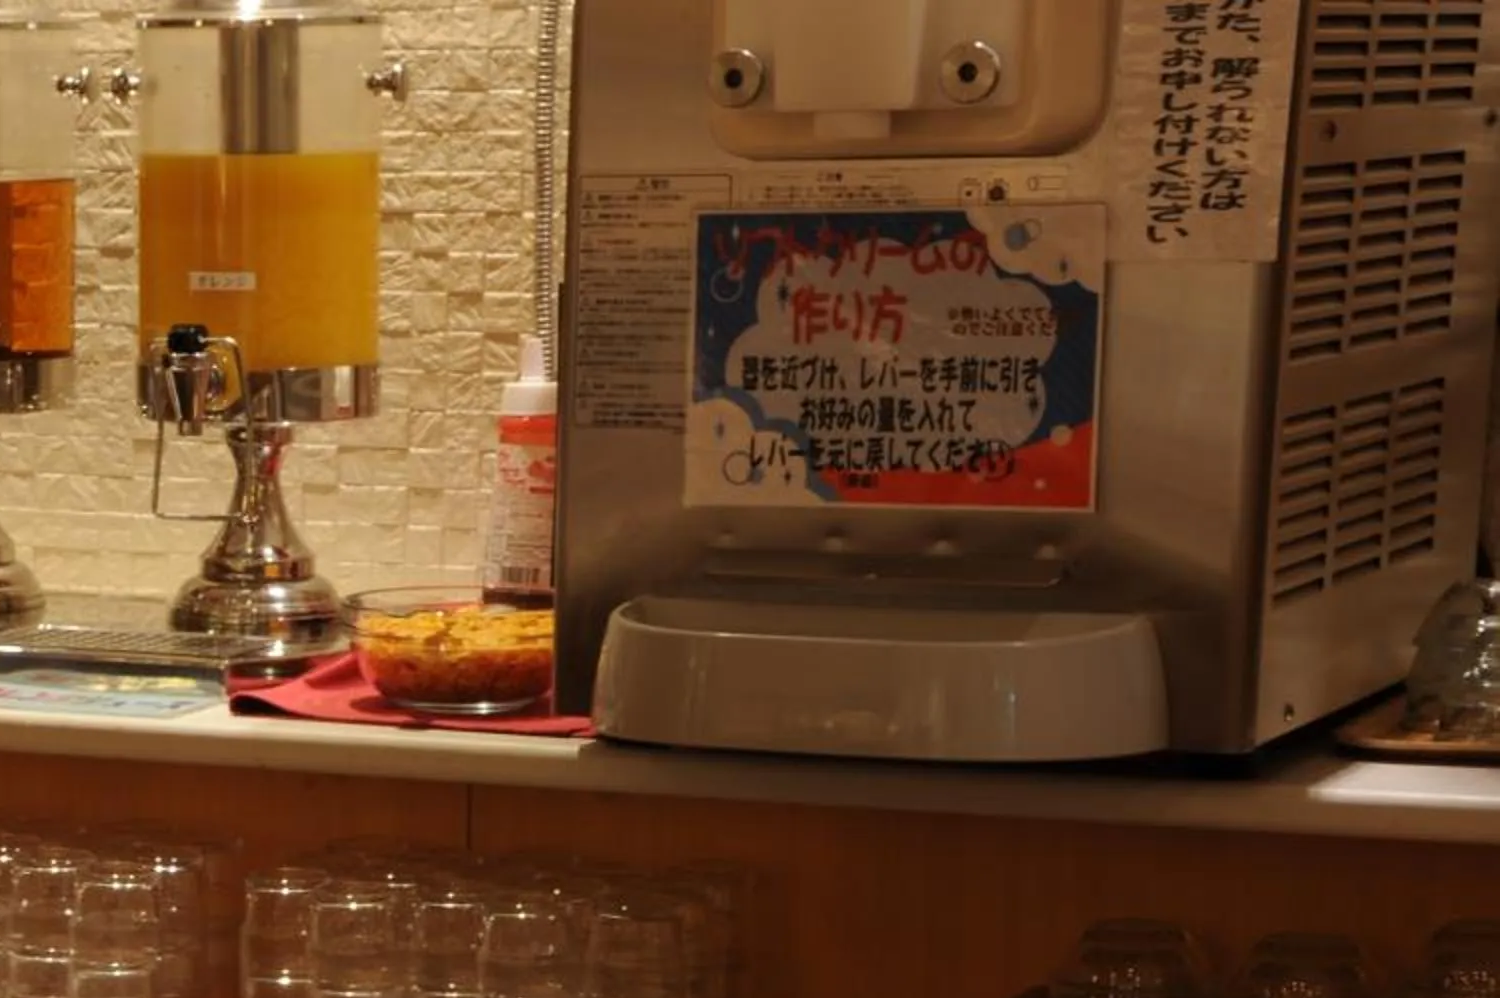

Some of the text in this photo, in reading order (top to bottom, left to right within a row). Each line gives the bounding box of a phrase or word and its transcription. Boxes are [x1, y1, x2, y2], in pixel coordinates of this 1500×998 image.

[712, 220, 992, 281] ソフトクリームの
[790, 284, 909, 344] 作り方
[799, 397, 977, 433] お好みの量を入れて
